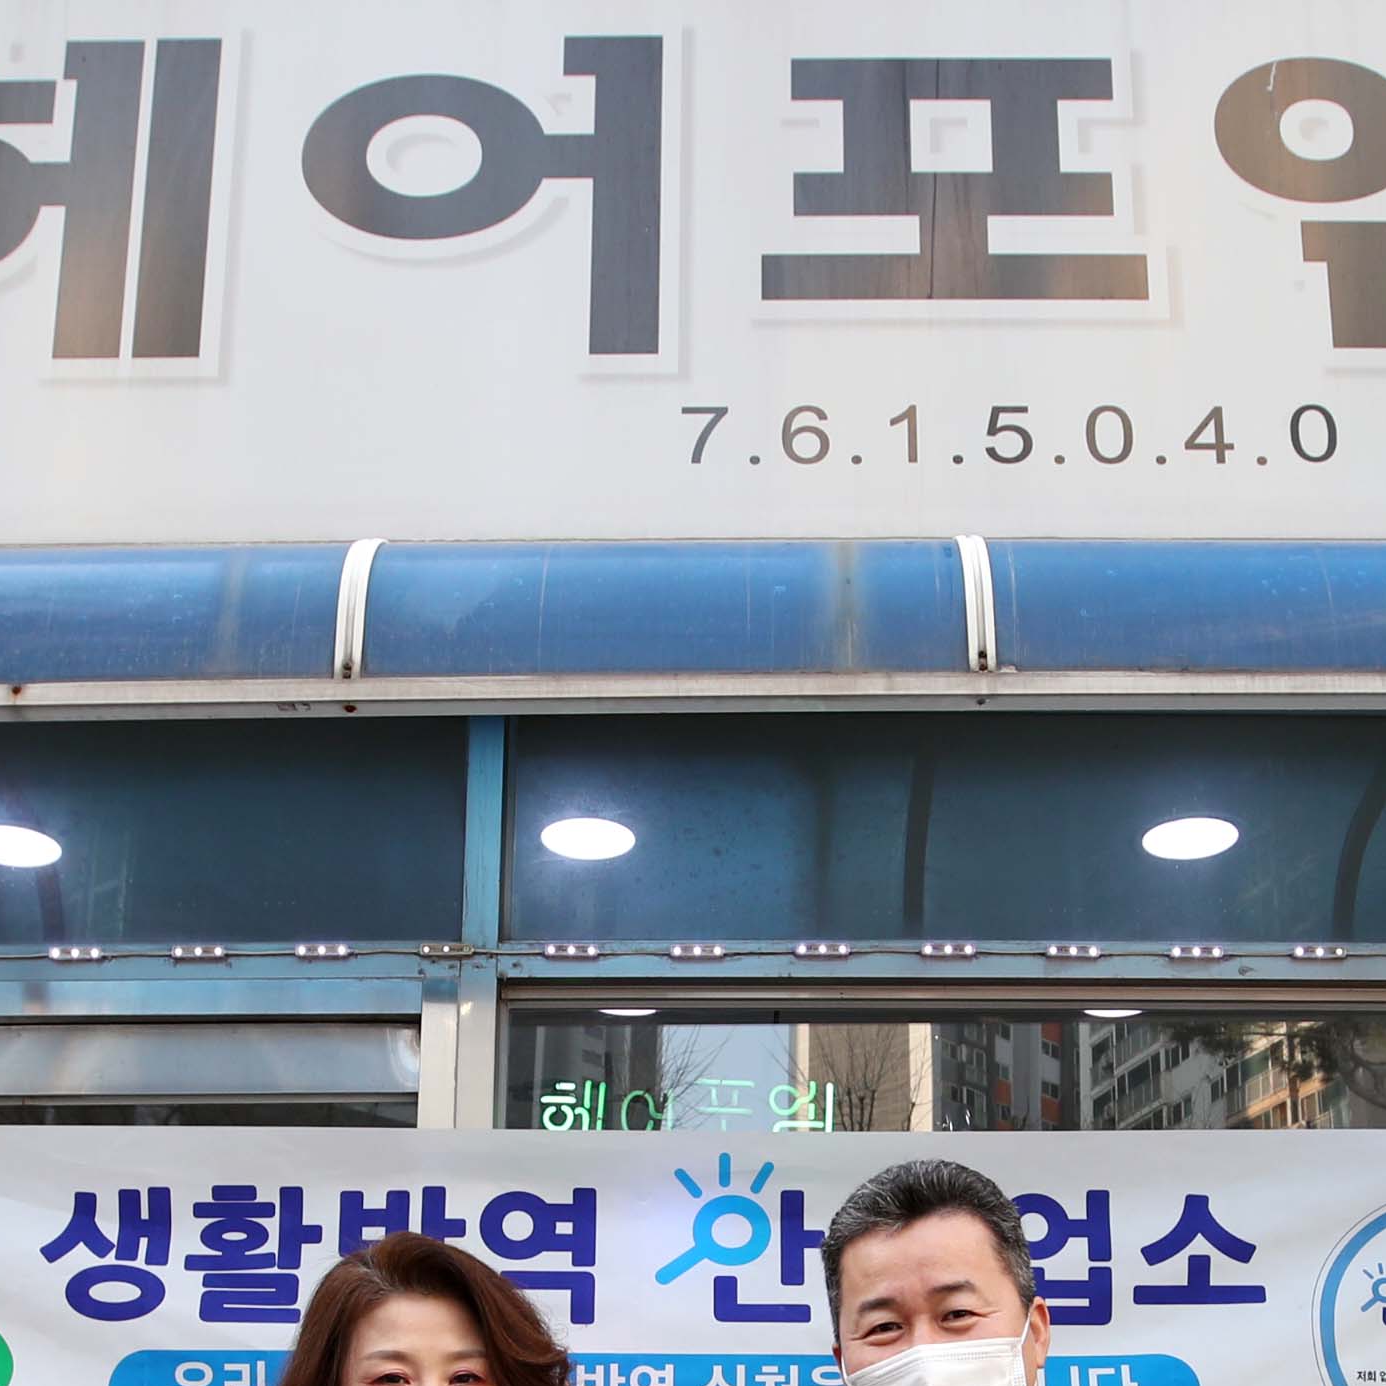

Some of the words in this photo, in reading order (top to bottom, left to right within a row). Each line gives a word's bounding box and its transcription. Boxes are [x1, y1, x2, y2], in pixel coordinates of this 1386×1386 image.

[678, 402, 1340, 467] 7.6.1.5.0.4.0
[654, 1170, 1267, 1326] 안업소
[1356, 1370, 1377, 1383] 저희
